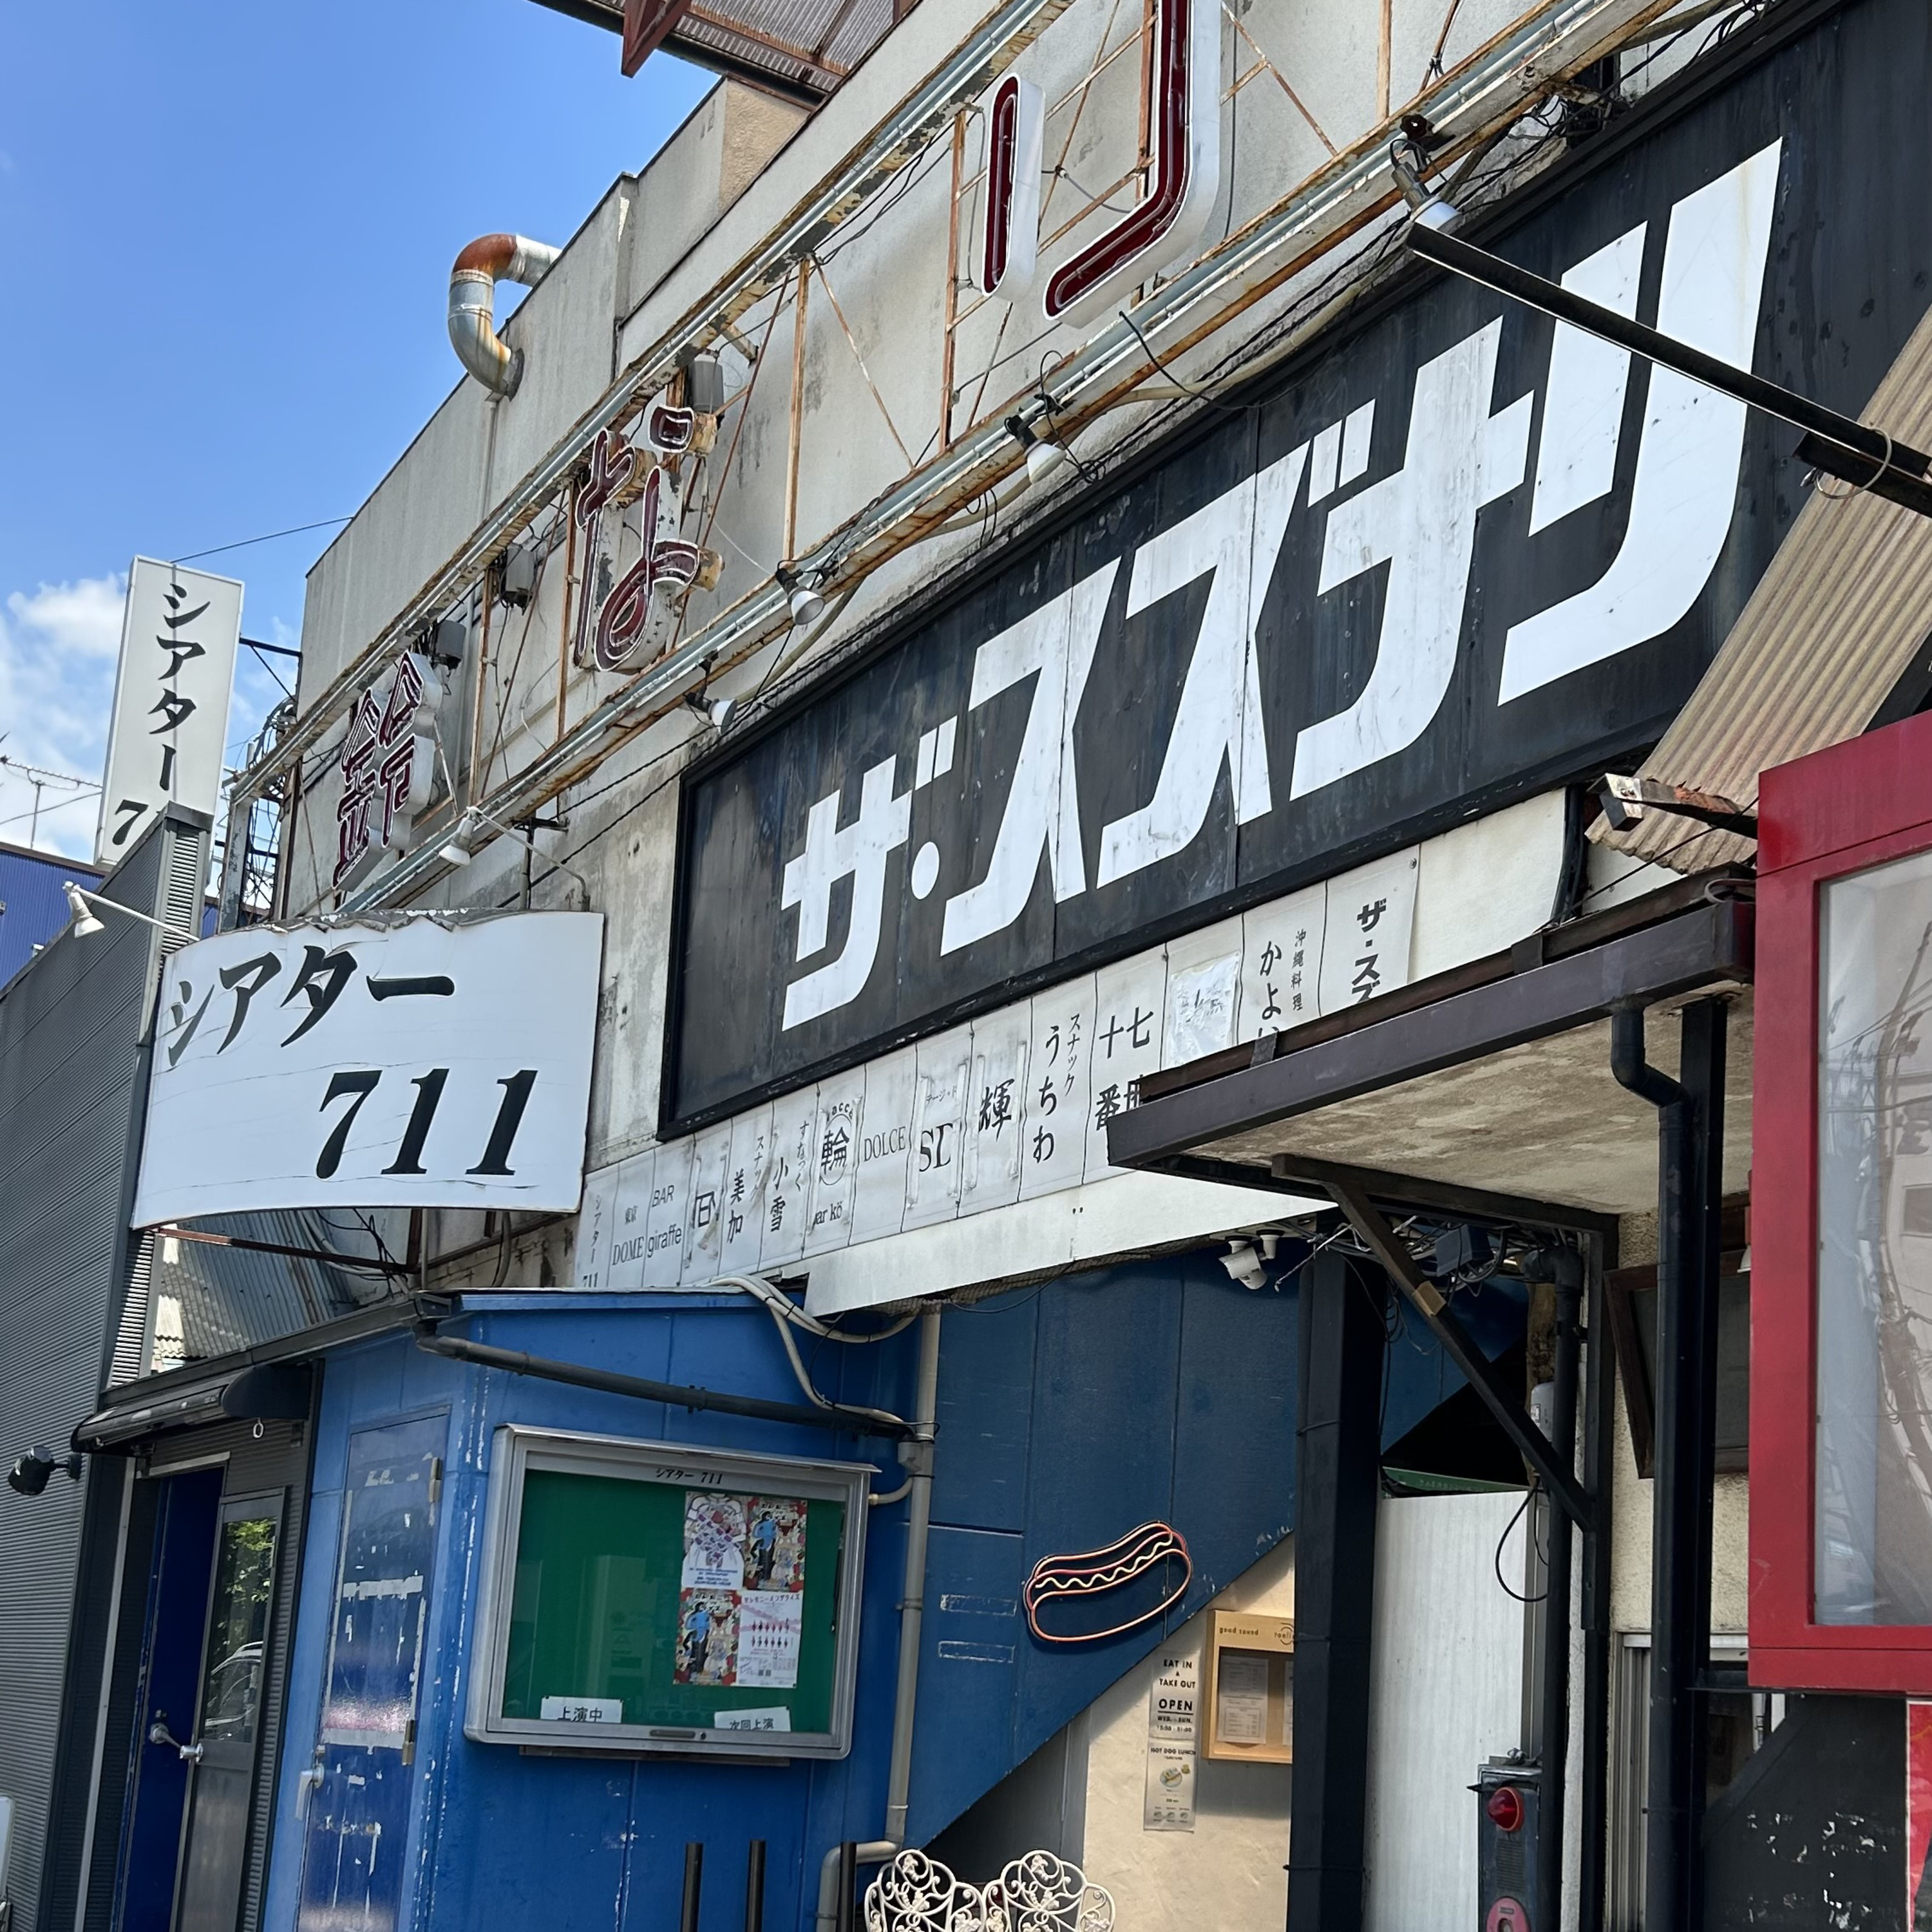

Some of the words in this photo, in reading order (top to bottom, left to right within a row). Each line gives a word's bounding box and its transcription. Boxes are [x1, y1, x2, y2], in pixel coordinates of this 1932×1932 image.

[780, 137, 1783, 1030] ザ・スズナリ
[148, 583, 211, 791] シアター
[1290, 929, 1307, 1012] 沖縄料理
[167, 945, 455, 1067] シアター
[1064, 1013, 1081, 1098] スナック
[316, 1068, 538, 1179] 711
[978, 1078, 1015, 1142] 輝
[1033, 1025, 1059, 1164] うちわ
[795, 1122, 810, 1192] すなっく
[821, 1126, 850, 1175] 輪
[864, 1126, 906, 1162] DOLCE
[591, 1194, 602, 1264] シアター
[651, 1184, 675, 1208] BAR
[727, 1168, 745, 1244] 美加
[770, 1157, 789, 1233] 小雪
[647, 1223, 683, 1258] giraffe
[656, 1468, 695, 1481] シアター
[700, 1472, 723, 1484] 711
[556, 1705, 603, 1723] 上演中
[1159, 1678, 1178, 1687] TAKE
[1180, 1680, 1196, 1689] OUT
[1159, 1698, 1193, 1711] OPEN
